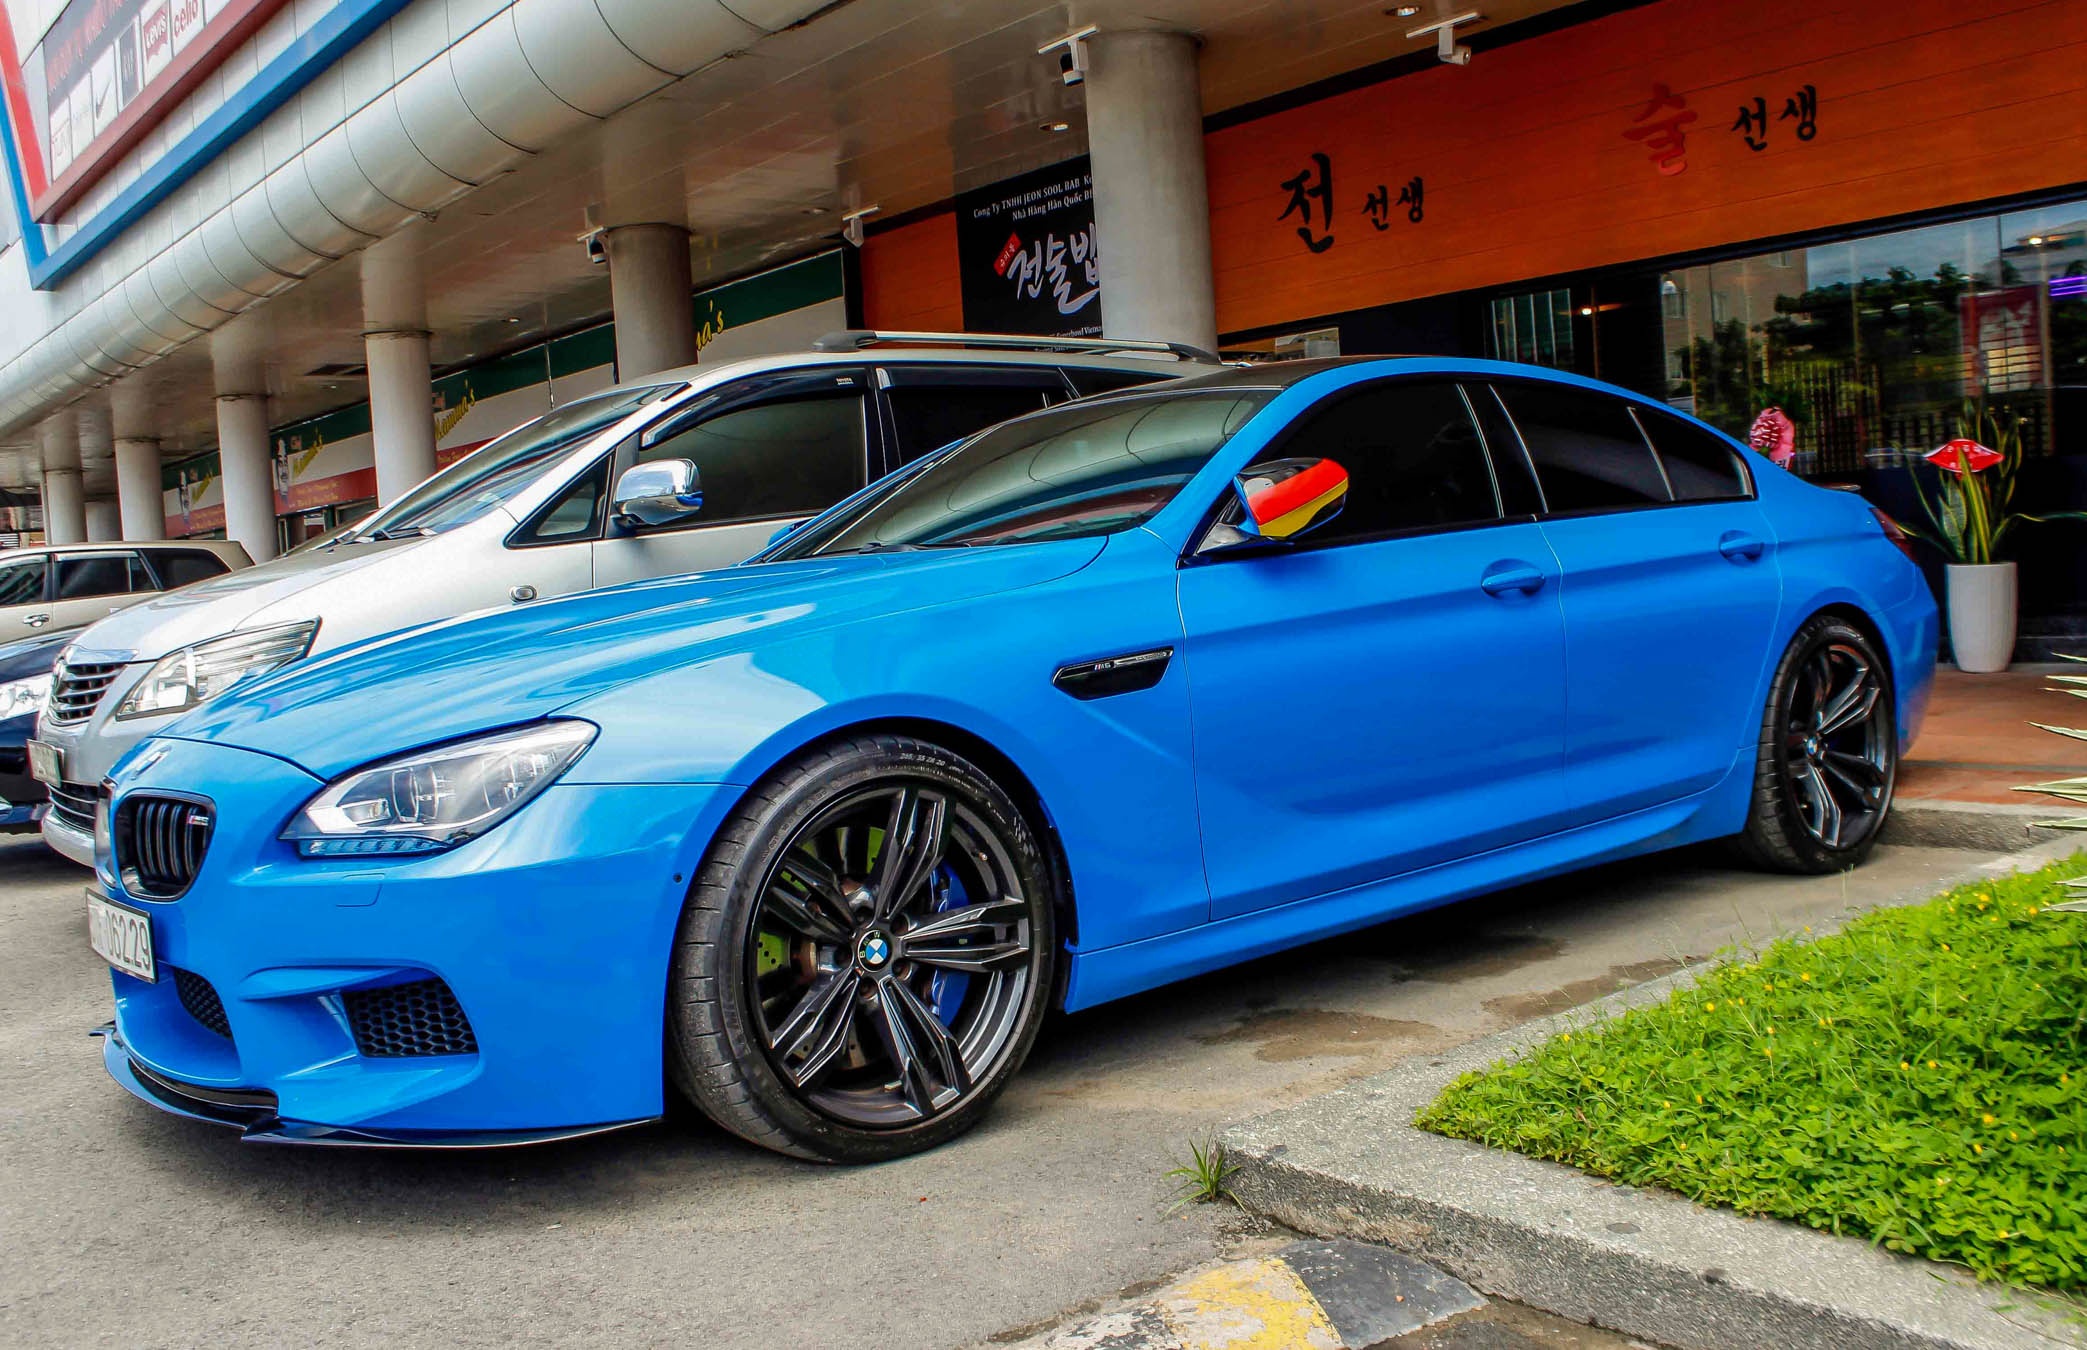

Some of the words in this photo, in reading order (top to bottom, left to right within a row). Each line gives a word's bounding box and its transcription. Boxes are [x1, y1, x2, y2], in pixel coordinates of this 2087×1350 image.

[1732, 84, 1818, 152] 선생
[1023, 189, 1042, 206] JEON
[1043, 183, 1063, 197] SOOL
[1360, 176, 1425, 232] 선생
